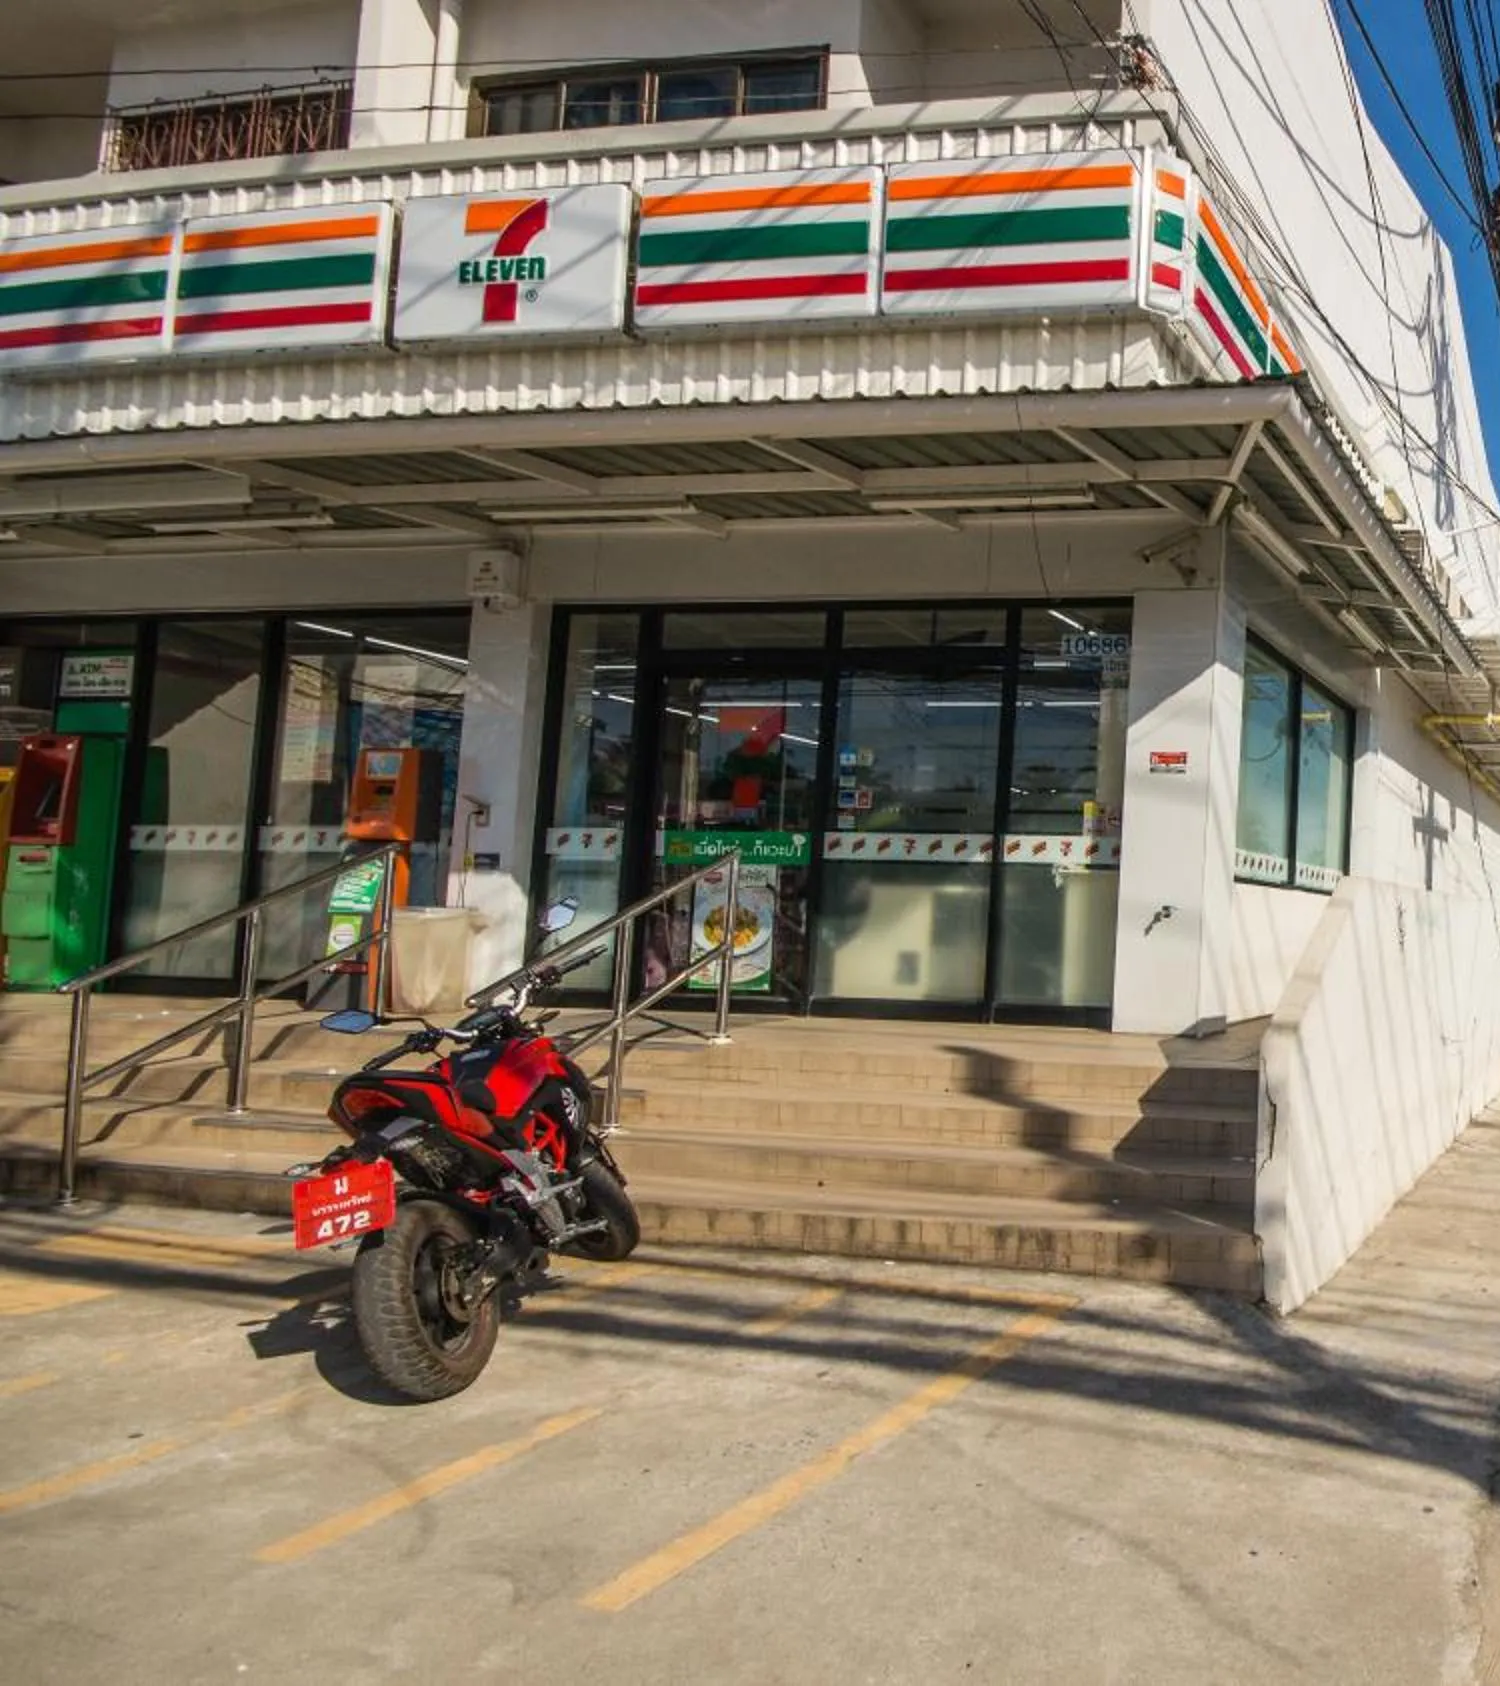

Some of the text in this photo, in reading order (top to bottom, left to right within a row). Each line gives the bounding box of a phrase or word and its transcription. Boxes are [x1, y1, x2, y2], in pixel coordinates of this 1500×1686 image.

[464, 198, 549, 324] 7
[1063, 636, 1127, 655] 10686
[317, 1209, 371, 1239] 472
